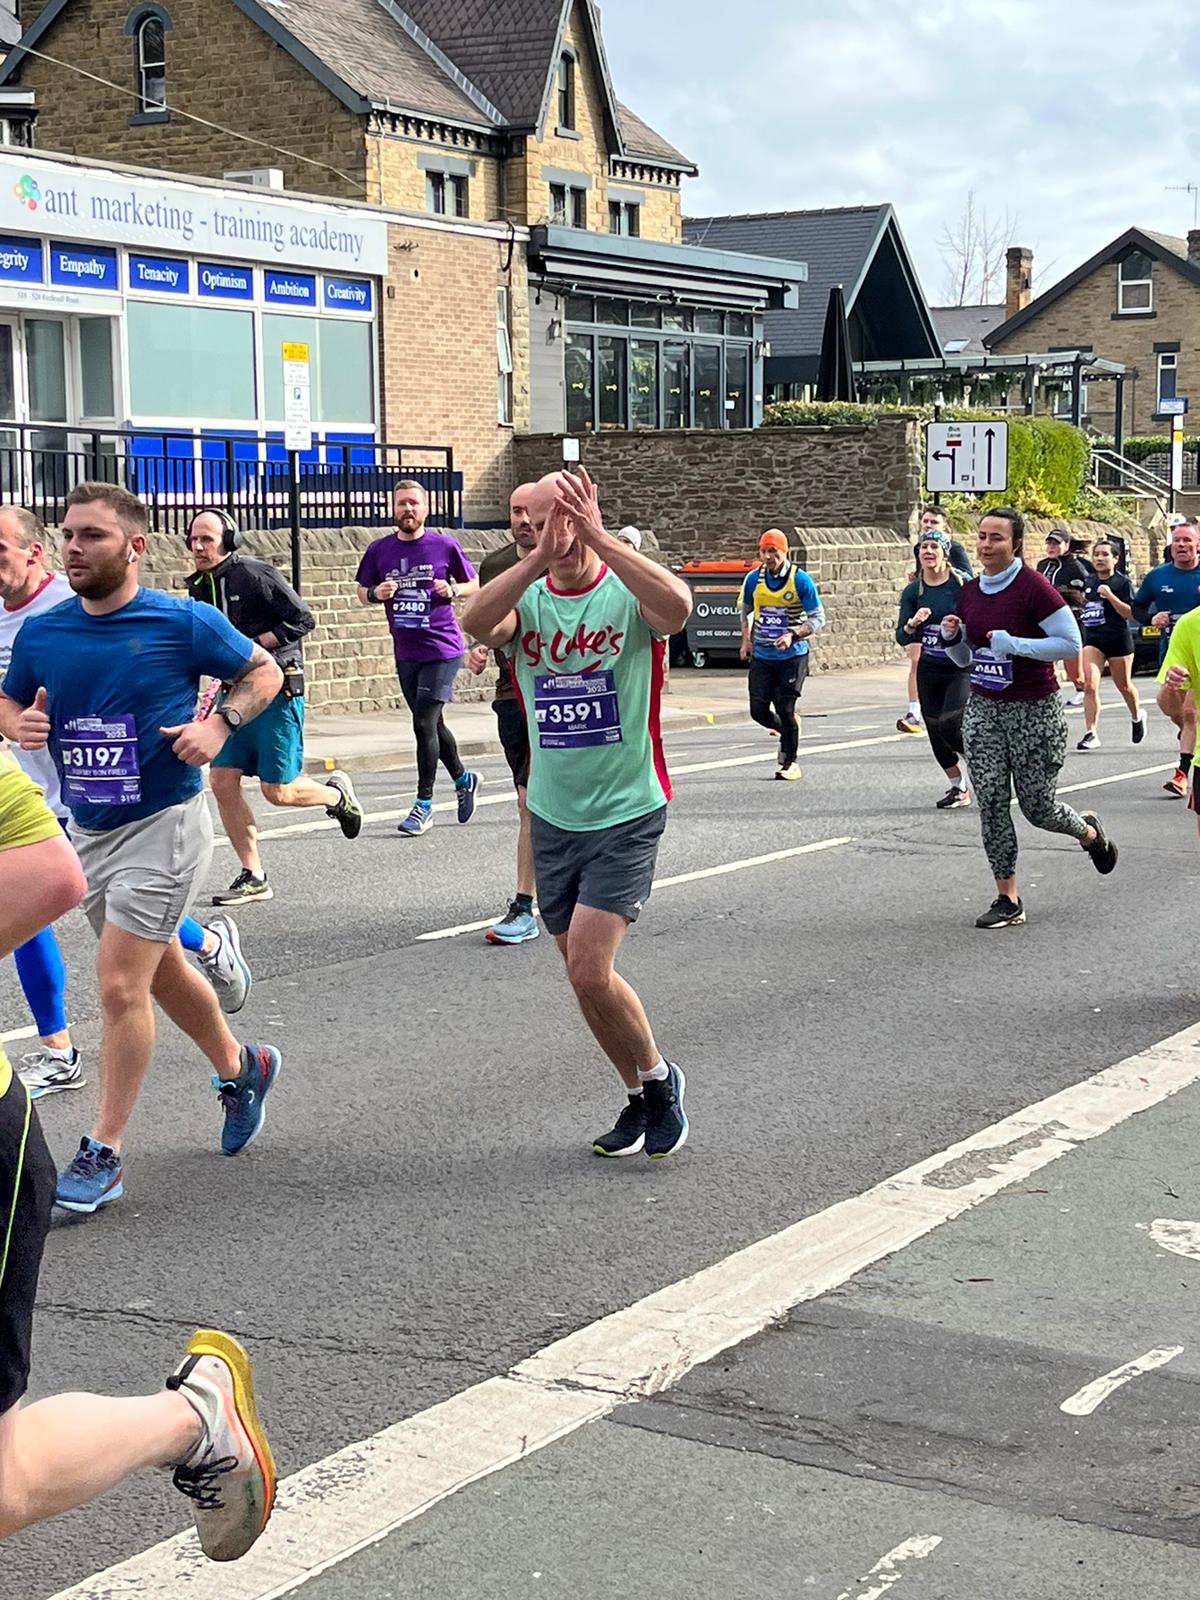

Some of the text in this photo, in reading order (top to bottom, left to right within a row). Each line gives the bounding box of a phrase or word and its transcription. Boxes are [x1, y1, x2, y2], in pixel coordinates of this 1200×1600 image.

[44, 187, 78, 216] ant
[91, 191, 194, 241] marketing
[213, 207, 285, 252] training
[290, 220, 364, 262] academy
[59, 255, 106, 279] Empathy
[137, 264, 179, 287] Tenacity
[202, 270, 247, 290] Optimism
[269, 280, 310, 298] Ambition
[327, 284, 367, 305] Creativity
[522, 623, 624, 666] St Luke's
[585, 685, 607, 694] 2023
[549, 701, 602, 724] 3591
[72, 747, 124, 766] 3197
